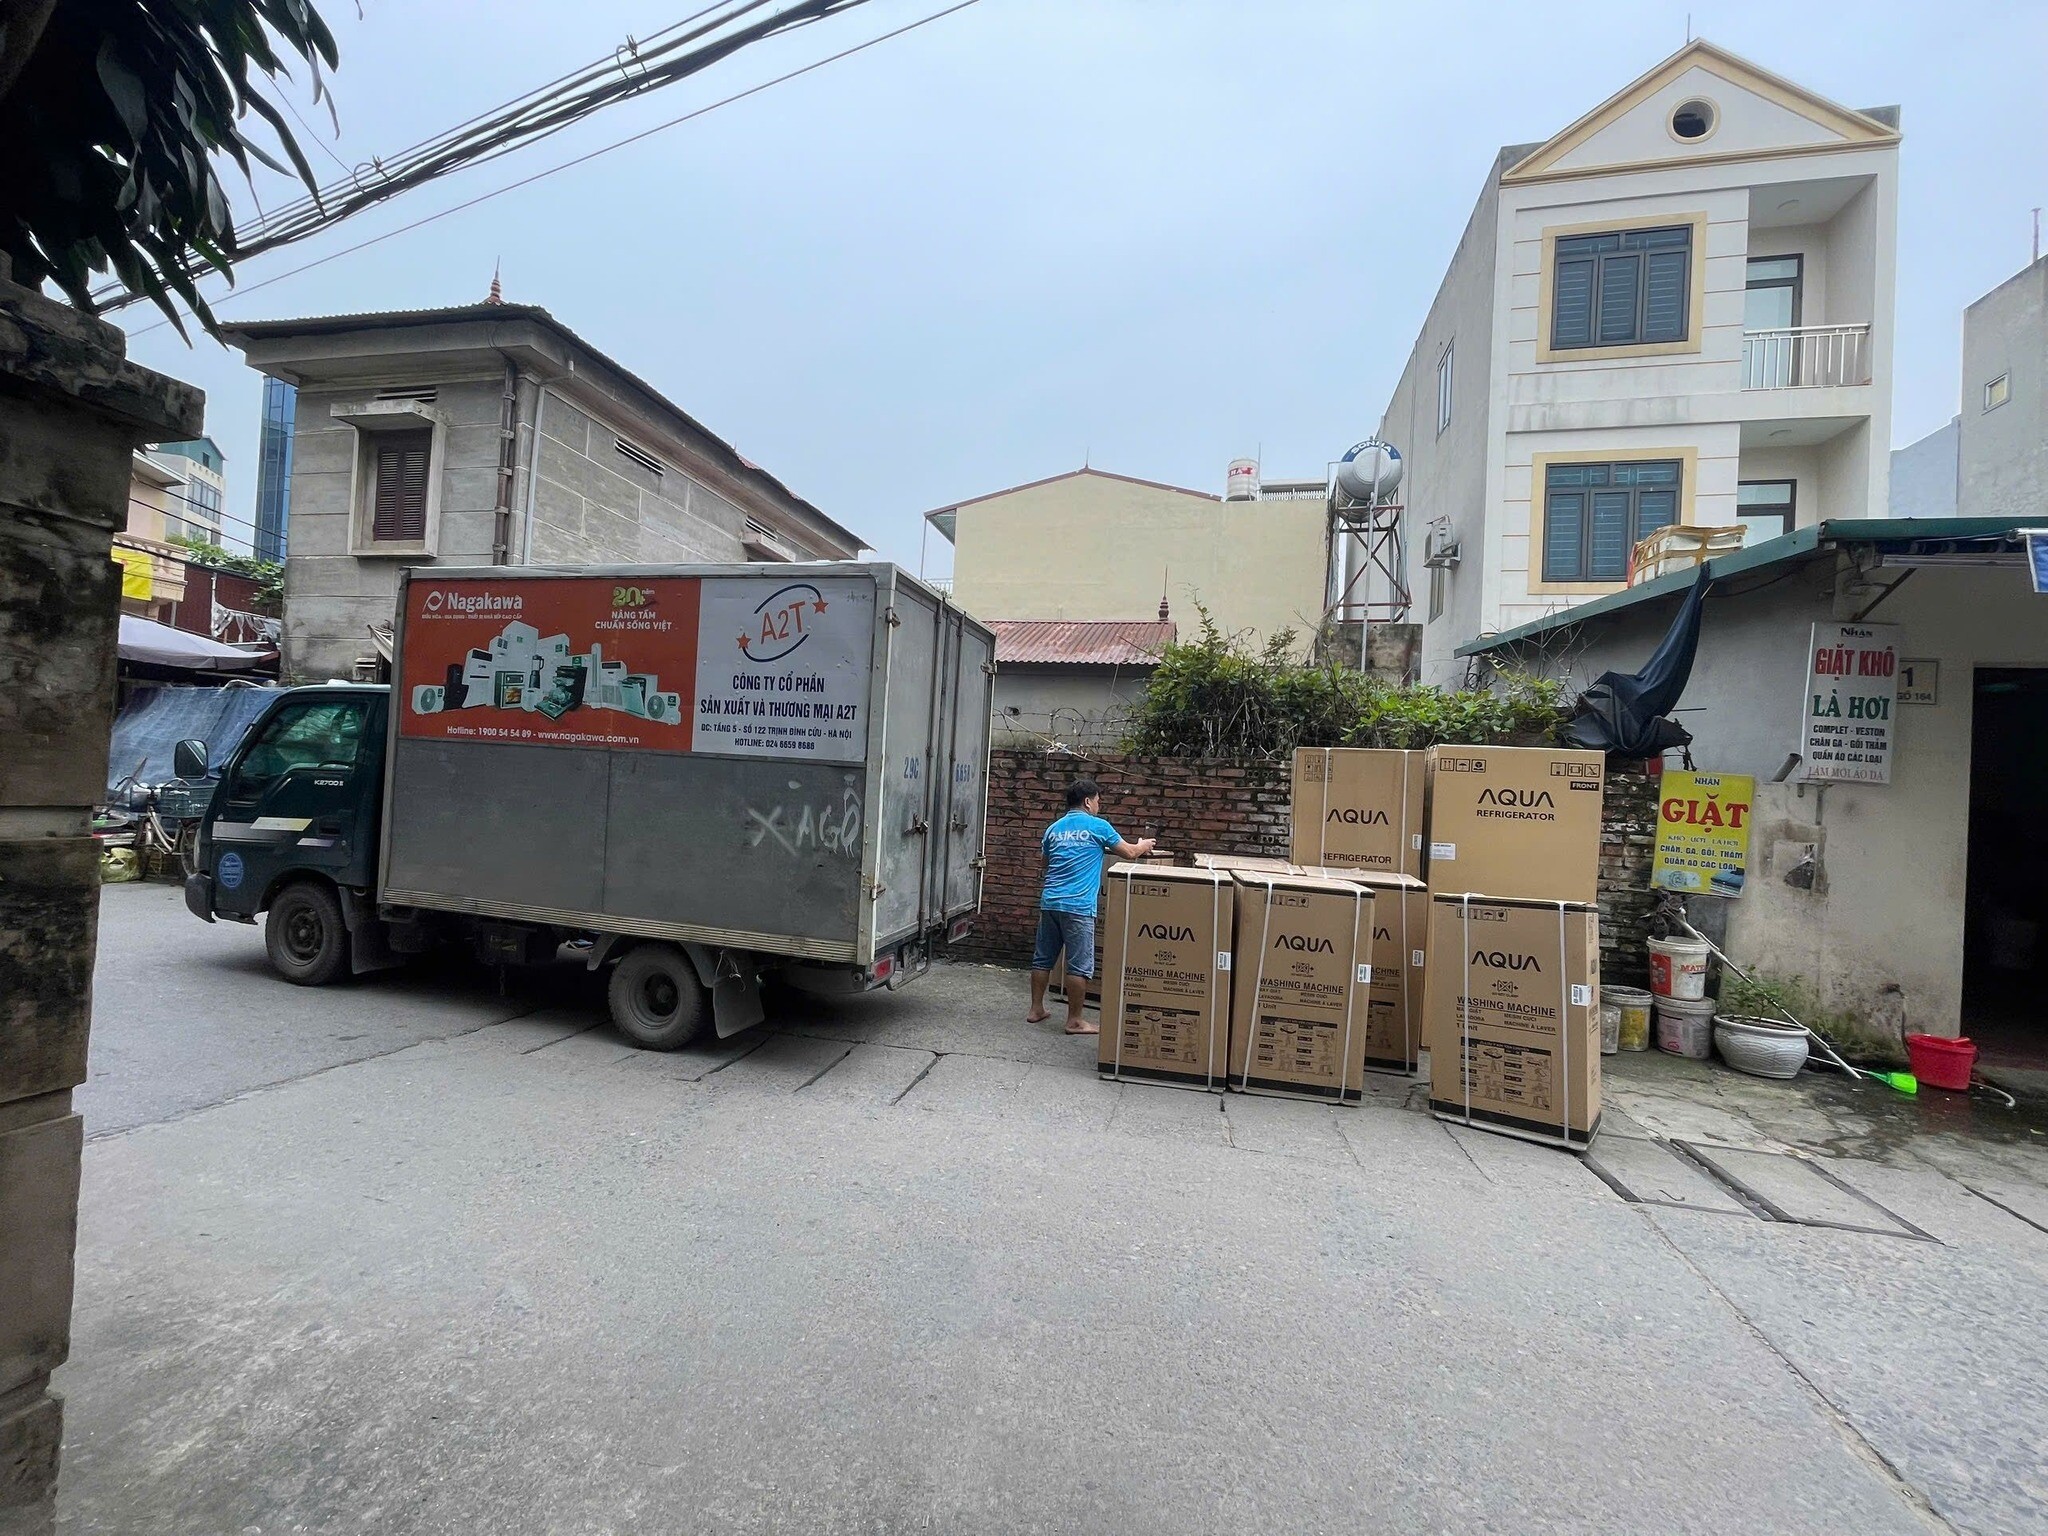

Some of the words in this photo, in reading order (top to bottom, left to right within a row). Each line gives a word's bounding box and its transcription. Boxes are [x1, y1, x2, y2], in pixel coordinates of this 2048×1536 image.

[447, 592, 523, 612] Nagakawa
[653, 619, 672, 632] VIỆT
[760, 601, 806, 645] A2T
[1815, 643, 1855, 681] GIẶT
[1858, 645, 1895, 677] KHÔ
[732, 672, 760, 691] CÔNG
[763, 675, 776, 691] TY
[778, 670, 794, 692] CỔ
[700, 694, 721, 714] SẢN
[723, 695, 751, 716] XUẤT
[753, 698, 766, 717] VÀ
[769, 701, 811, 719] THƯƠNG
[813, 703, 834, 723] MẠI
[836, 704, 858, 721] A2T
[1812, 688, 1841, 718] LÀ
[1848, 695, 1890, 721] HƠI
[447, 726, 477, 736] Hotline:
[478, 727, 497, 737] 1900
[498, 728, 509, 737] 54
[510, 728, 521, 738] 54
[521, 729, 532, 739] 89
[538, 732, 640, 745] www.nagakawa.com.vn
[732, 724, 738, 733] 5
[754, 726, 766, 735] 122
[1813, 724, 1849, 735] COMPLET
[1855, 726, 1886, 737] VESTON
[734, 737, 764, 748] HOTLINE:
[765, 739, 779, 748] 024
[1832, 738, 1843, 748] GA
[1864, 754, 1883, 766] LOẠI
[1572, 782, 1598, 790] FRONT
[1477, 788, 1555, 809] AQUA
[1326, 808, 1389, 826] AQUA
[1476, 809, 1555, 821] REFRIGERATOR
[1661, 792, 1749, 833] GIẶT
[1137, 924, 1196, 942] AQUA
[1274, 934, 1334, 954] AQUA
[1471, 950, 1541, 973] AQUA
[1124, 966, 1164, 978] WASHING
[1166, 970, 1206, 982] MACHINE
[1371, 966, 1400, 977] ACHINE
[1260, 977, 1301, 989] WASHING
[1303, 982, 1344, 994] MACHINE
[1507, 1003, 1556, 1017] MACHINE
